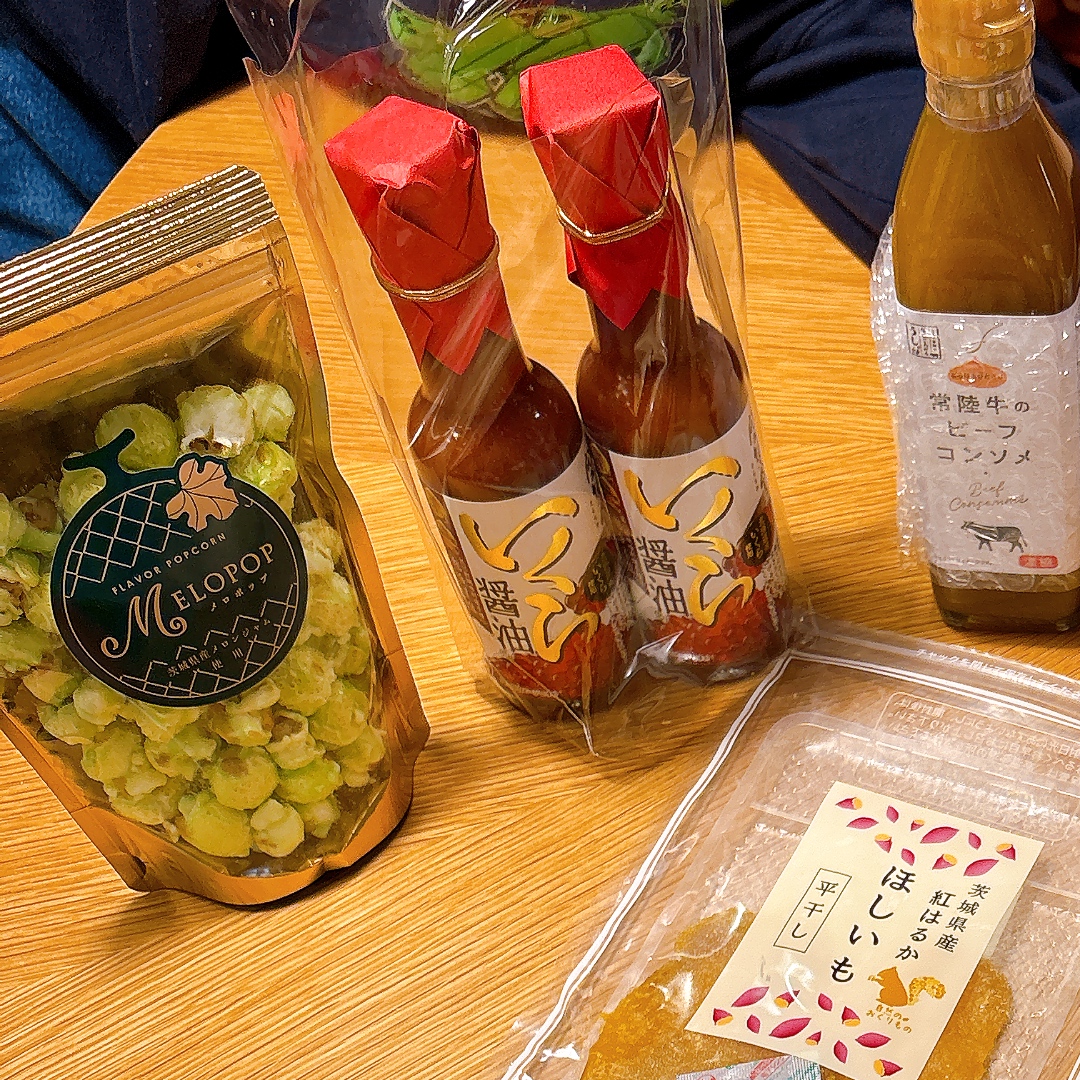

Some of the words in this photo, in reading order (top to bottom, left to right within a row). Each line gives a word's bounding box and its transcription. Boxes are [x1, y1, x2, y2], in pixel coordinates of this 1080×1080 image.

[930, 393, 1030, 414] 常陸牛の
[948, 421, 1017, 439] ビーフ
[936, 446, 1031, 465] コンソメ
[111, 565, 162, 596] FLAVOR
[165, 532, 227, 568] POPCORN
[209, 573, 269, 612] メロポップ
[100, 543, 276, 658] MELOPOP
[790, 879, 839, 939] 平干し
[830, 865, 917, 983] ほしいも
[895, 889, 957, 961] 紅はるか
[934, 883, 993, 954] 茨城県産
